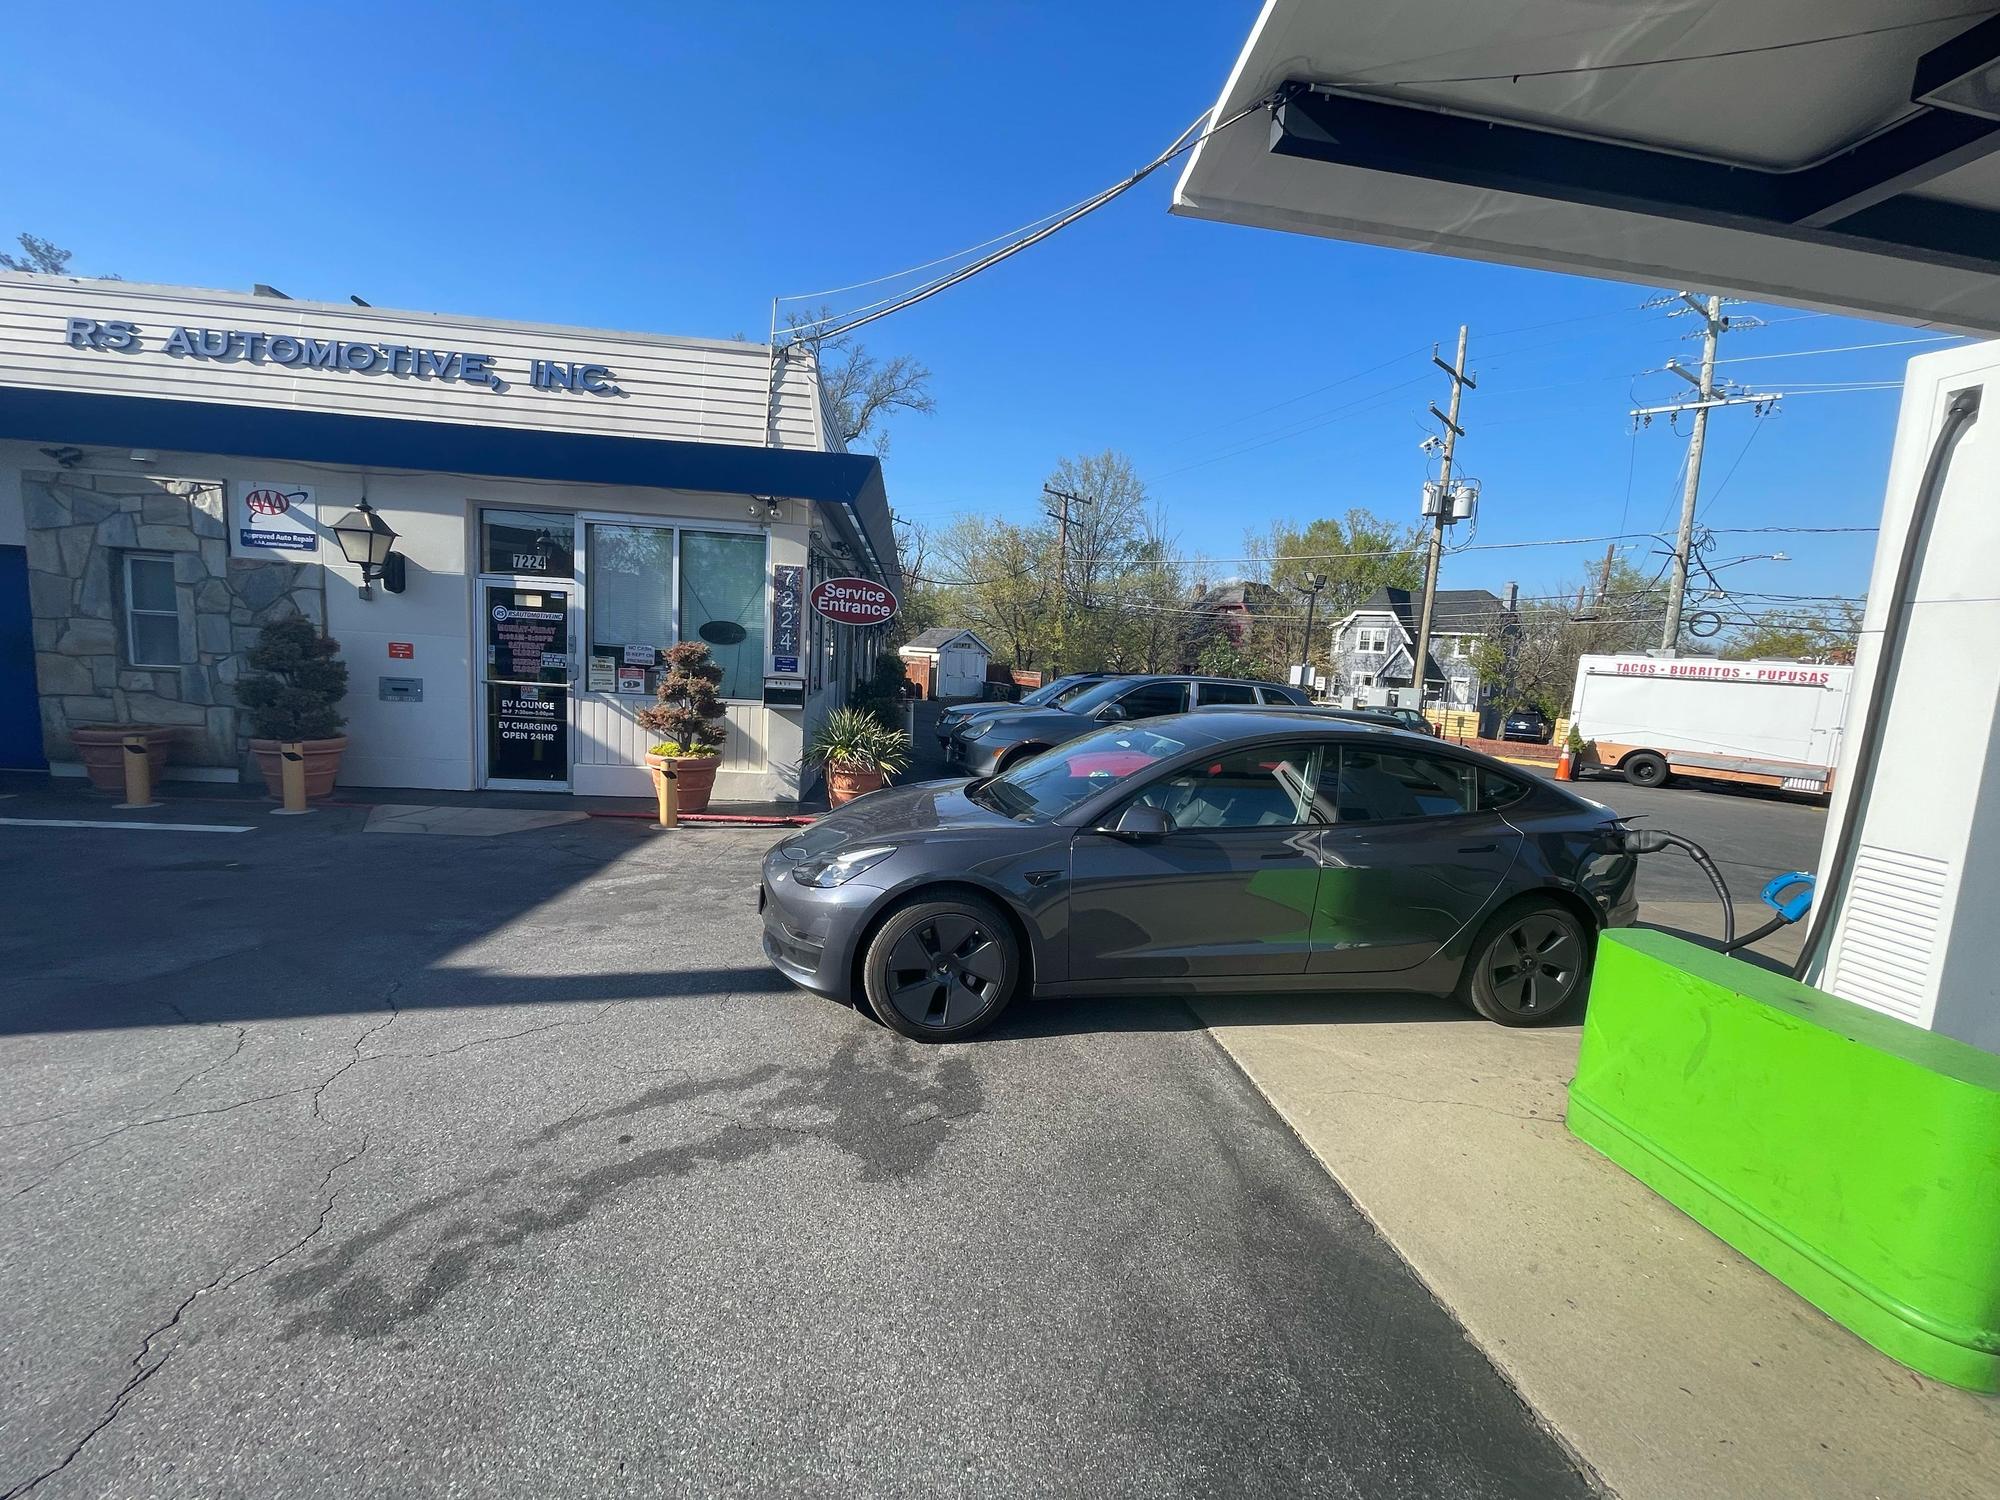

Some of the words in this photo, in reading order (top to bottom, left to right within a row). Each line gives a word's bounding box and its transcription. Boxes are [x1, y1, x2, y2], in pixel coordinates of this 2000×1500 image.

[65, 317, 136, 349] RS
[160, 325, 500, 392] AUTOMOTIVE,
[530, 358, 620, 394] INC.
[249, 490, 286, 515] AAA
[243, 531, 275, 541] Approved
[276, 533, 292, 541] Auto
[292, 535, 314, 544] Repair
[514, 555, 545, 569] 7224
[824, 583, 886, 603] Service
[780, 570, 794, 651] 7224
[818, 596, 891, 617] Entrance
[1616, 663, 1656, 674] TACOS
[1669, 665, 1740, 678] BURRITOS
[1757, 669, 1830, 684] PUPUSAS
[502, 700, 513, 708] EV
[516, 700, 555, 710] LOUNGE
[498, 721, 509, 729] EV
[511, 722, 558, 732] CHARGING
[502, 731, 528, 740] OPEN
[530, 733, 554, 741] 24HR
